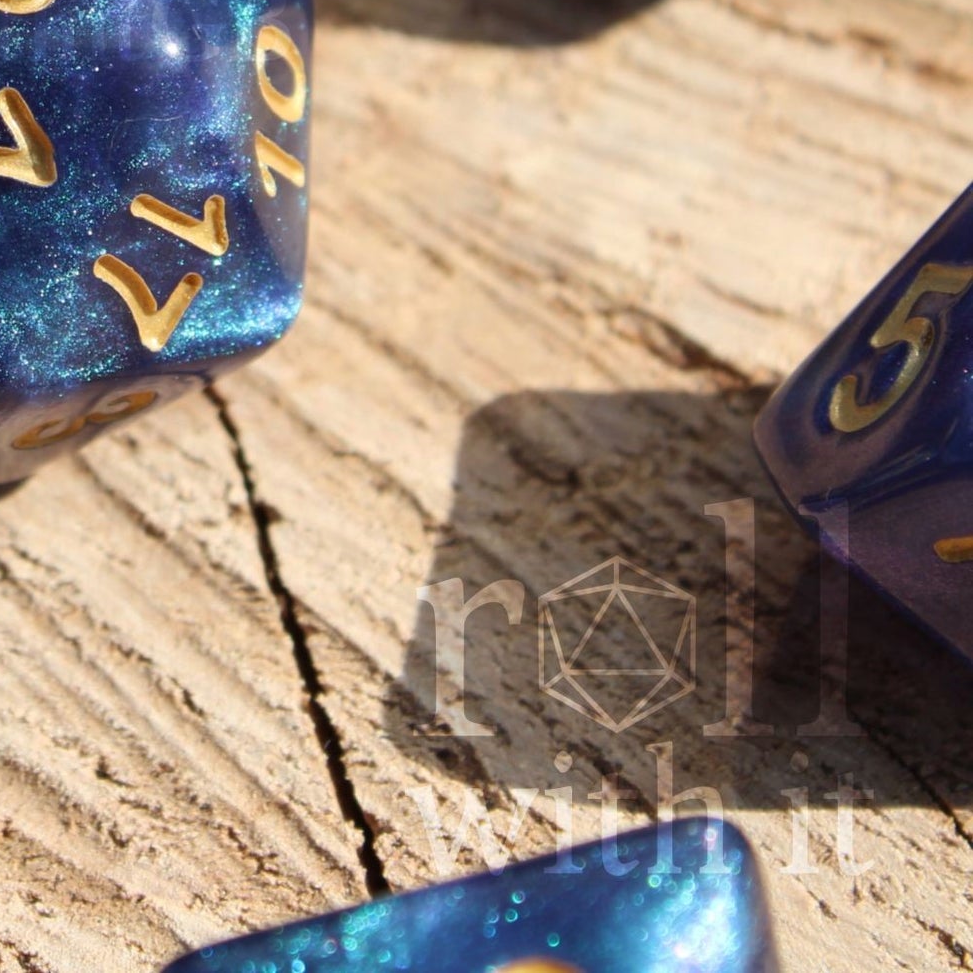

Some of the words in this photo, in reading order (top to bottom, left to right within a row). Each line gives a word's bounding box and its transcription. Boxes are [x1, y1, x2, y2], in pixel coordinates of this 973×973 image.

[256, 25, 305, 198] 10
[93, 192, 229, 352] 17
[830, 263, 973, 432] 5
